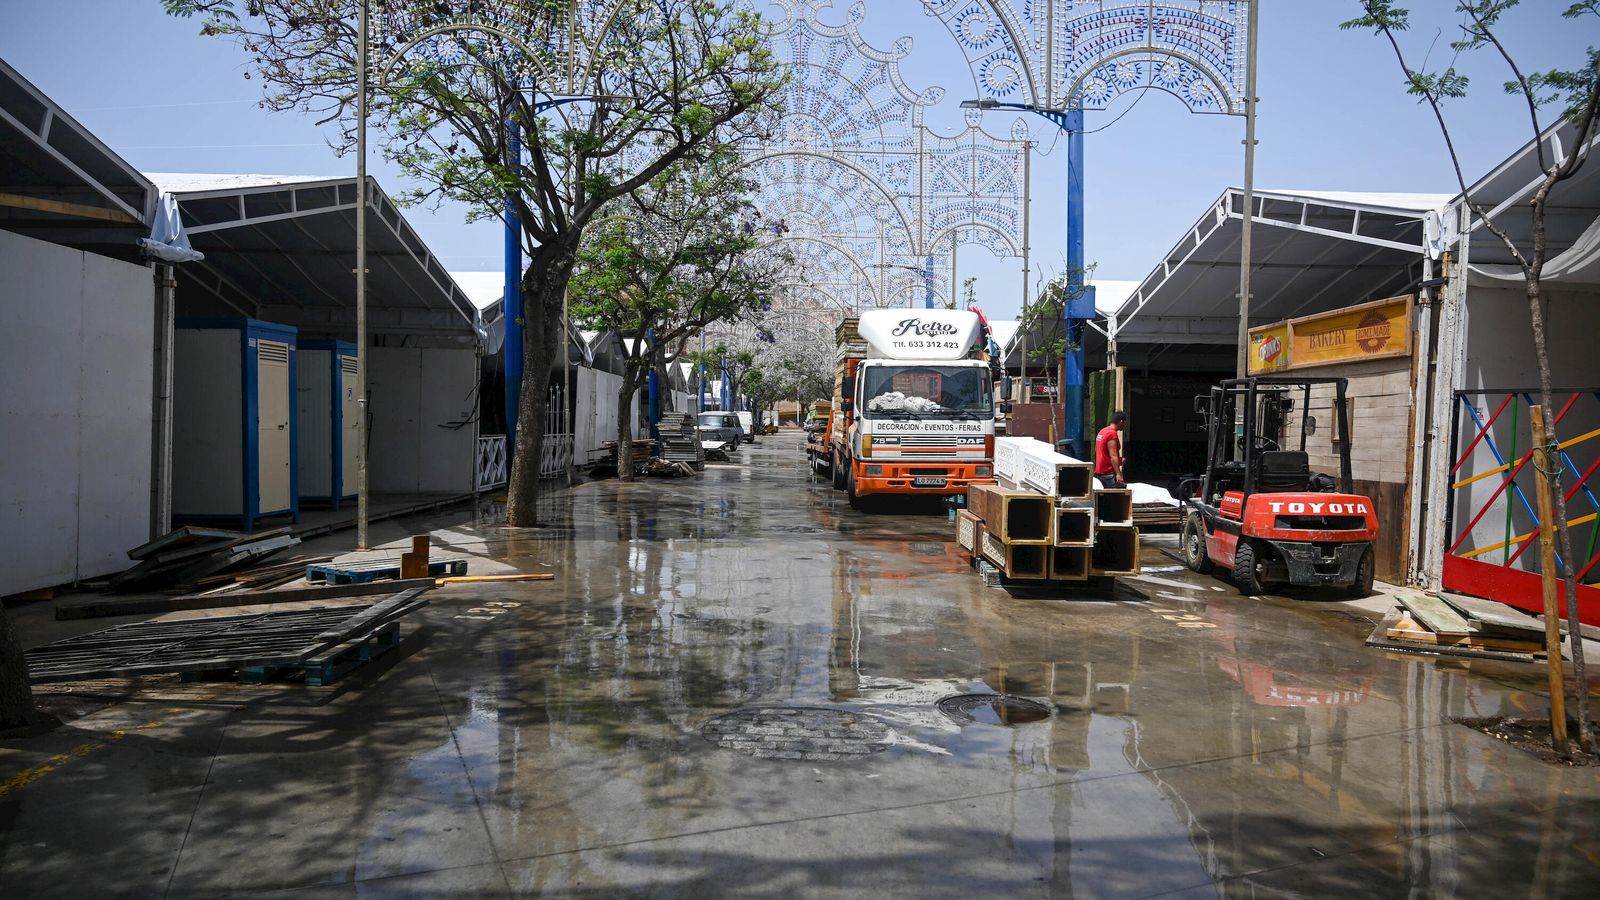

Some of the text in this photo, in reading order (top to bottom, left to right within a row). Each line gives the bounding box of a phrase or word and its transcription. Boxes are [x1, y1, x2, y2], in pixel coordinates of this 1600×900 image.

[892, 317, 958, 337] Retro
[1355, 324, 1391, 342] HOMEMADE
[943, 341, 959, 349] 423
[1309, 328, 1347, 350] BAKERY
[877, 423, 920, 431] DECORACION
[924, 423, 954, 432] EVENTOS
[958, 424, 982, 432] FERIAS
[1224, 496, 1241, 504] TOYOTA
[1268, 501, 1368, 514] TOYOTA
